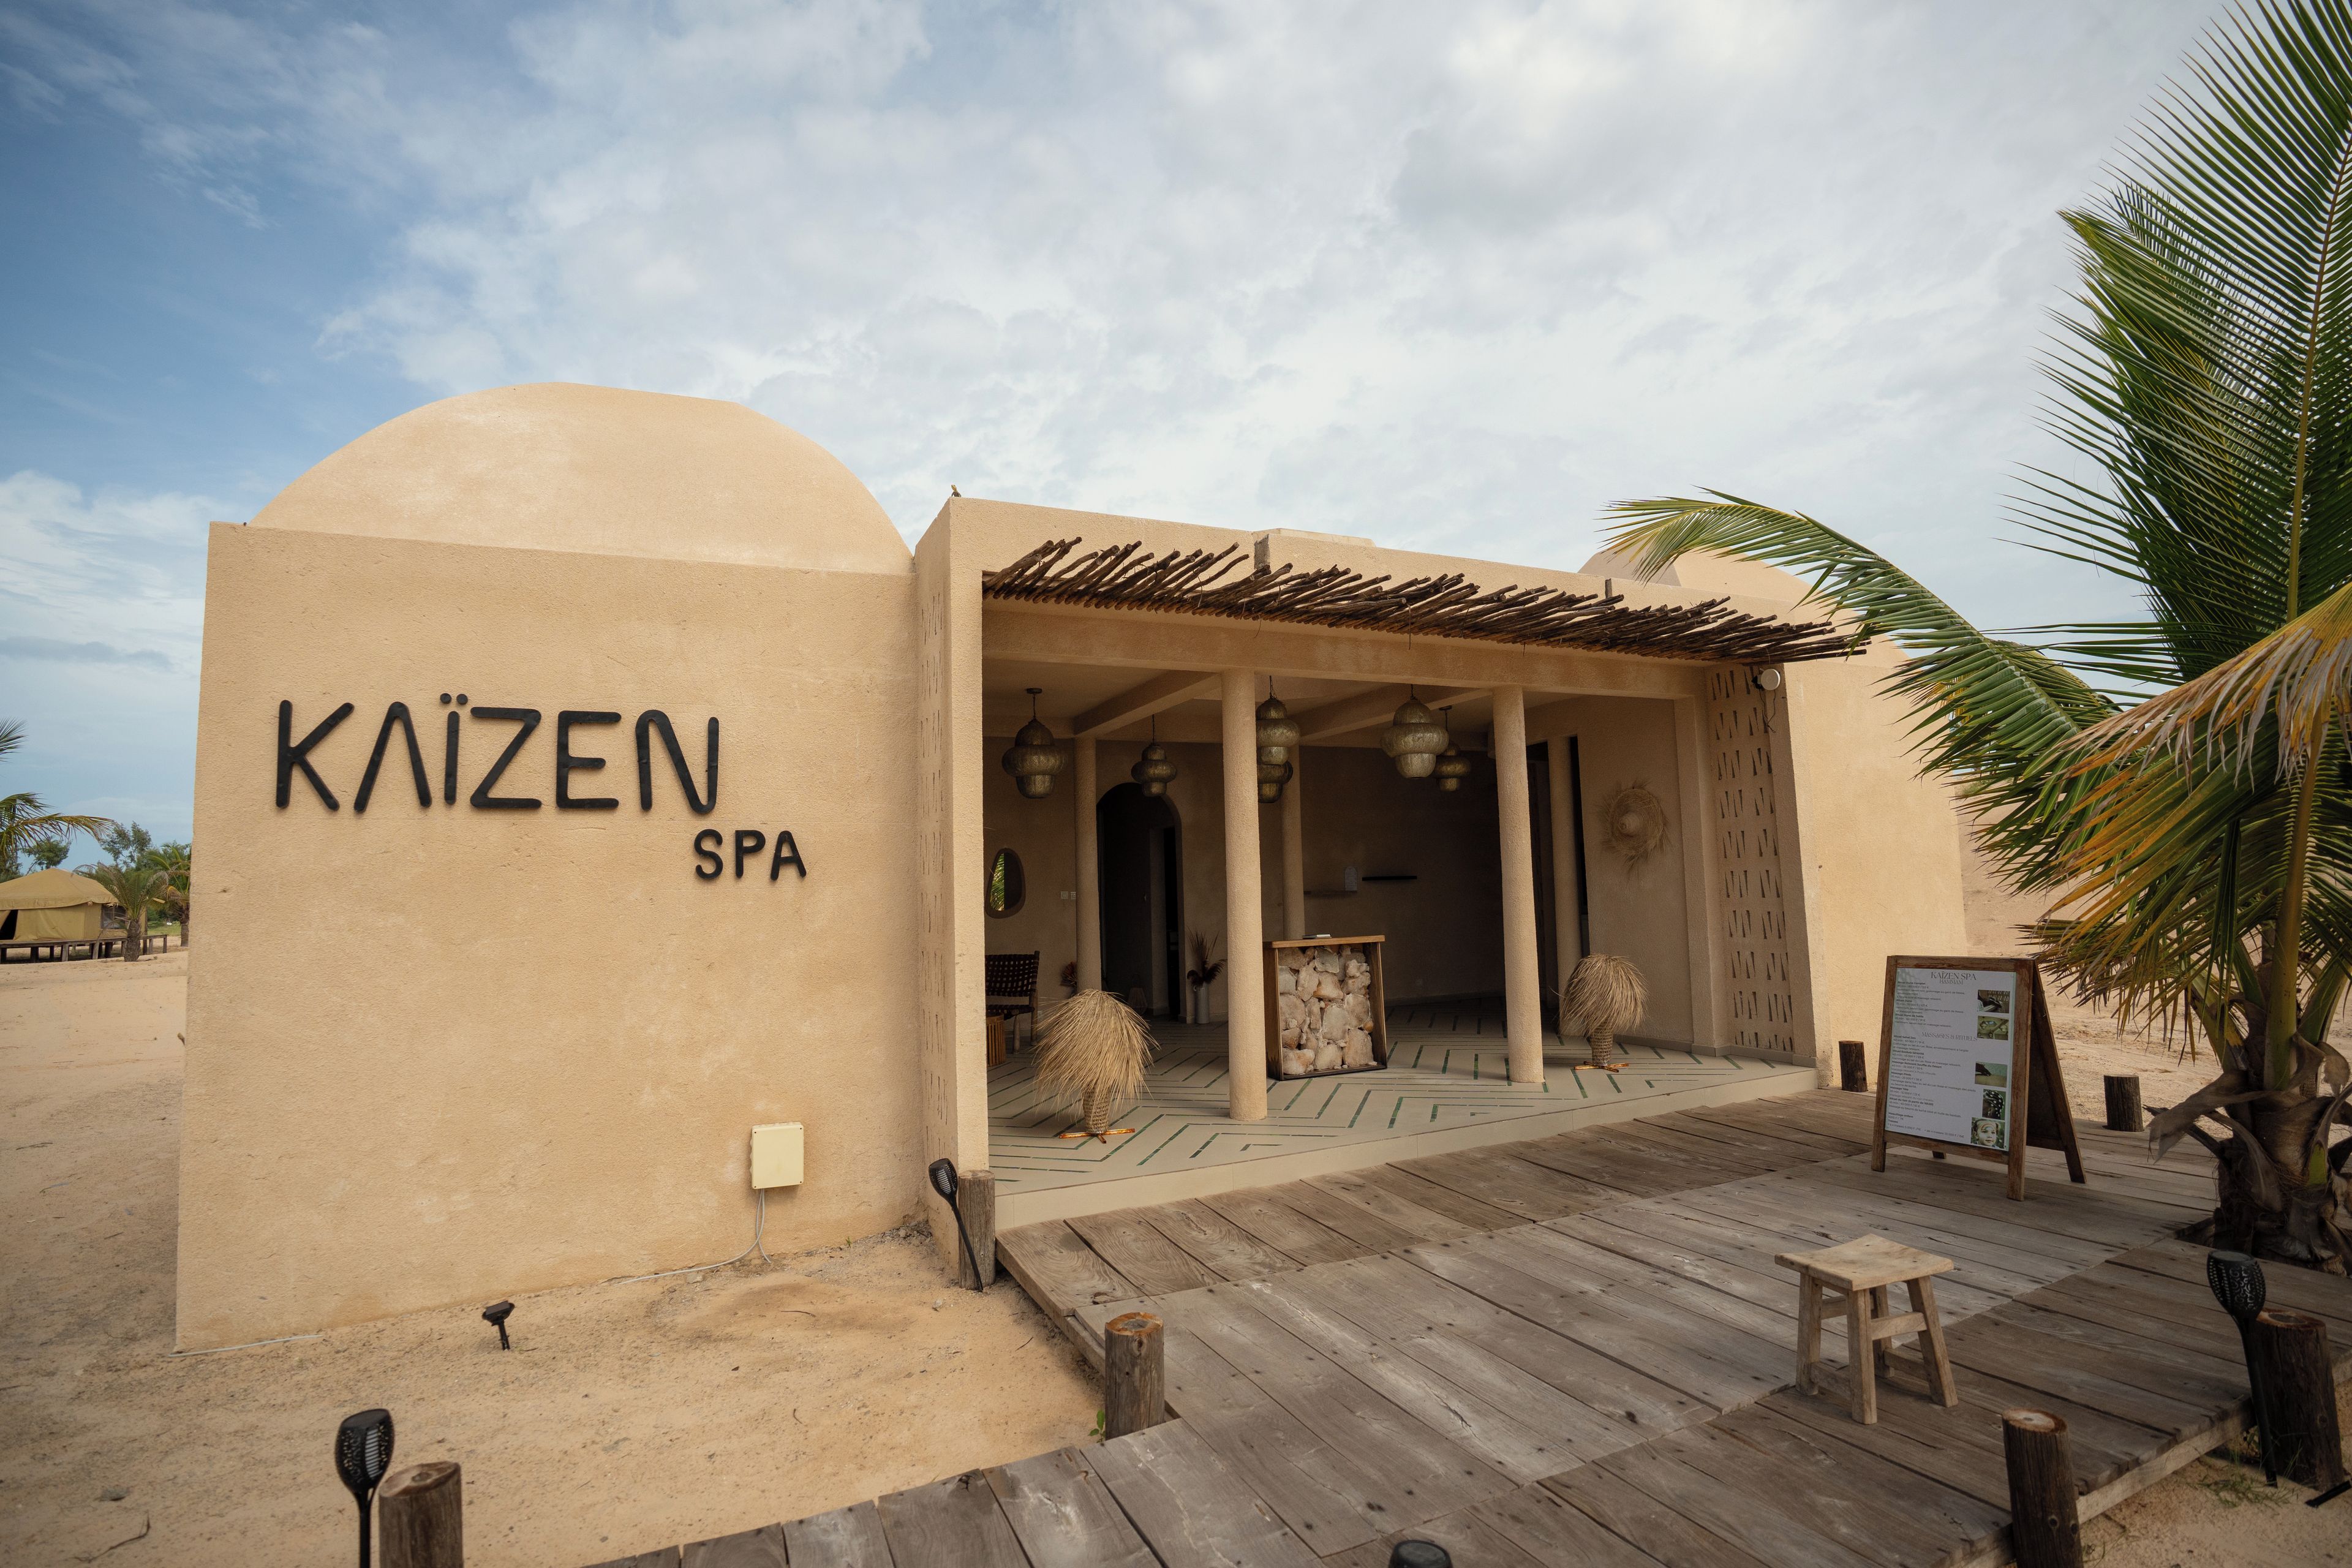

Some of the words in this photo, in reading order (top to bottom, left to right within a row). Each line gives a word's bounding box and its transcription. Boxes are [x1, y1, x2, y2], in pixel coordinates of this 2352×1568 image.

[276, 693, 720, 815] KAÏZEN
[694, 829, 807, 881] SPA
[1931, 970, 1960, 979] KAÏZEN
